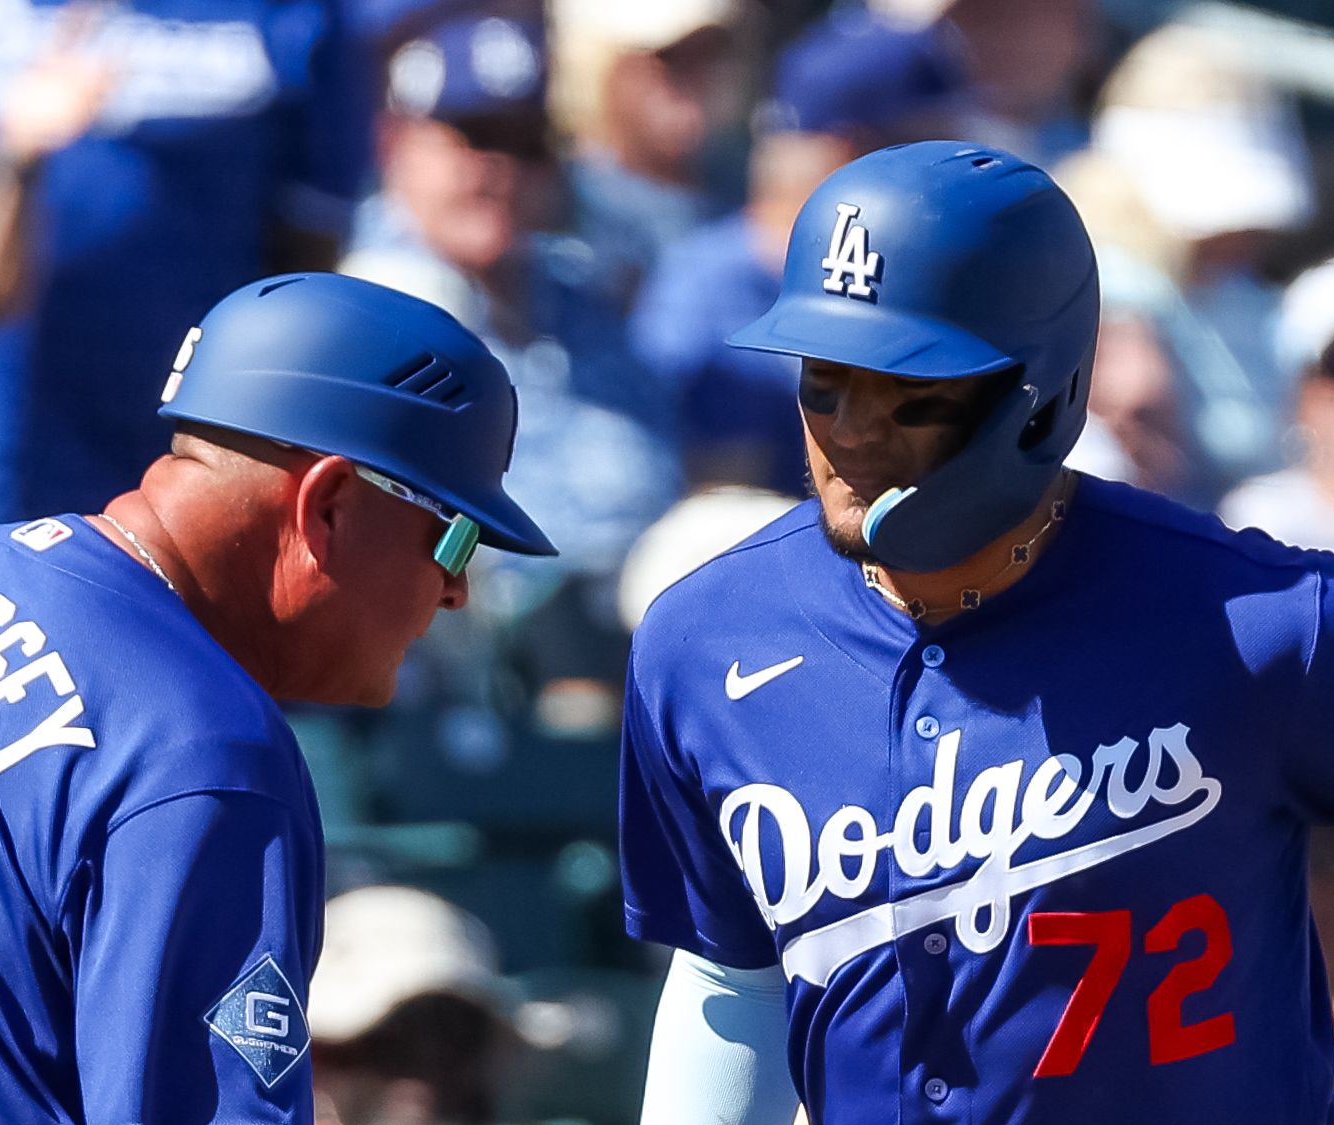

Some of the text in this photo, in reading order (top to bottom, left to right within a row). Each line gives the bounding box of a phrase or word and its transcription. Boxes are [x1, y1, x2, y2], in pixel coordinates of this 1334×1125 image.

[821, 202, 883, 302] LA
[719, 722, 1222, 954] Dodgers
[246, 991, 290, 1037] G
[1028, 893, 1237, 1079] 72
